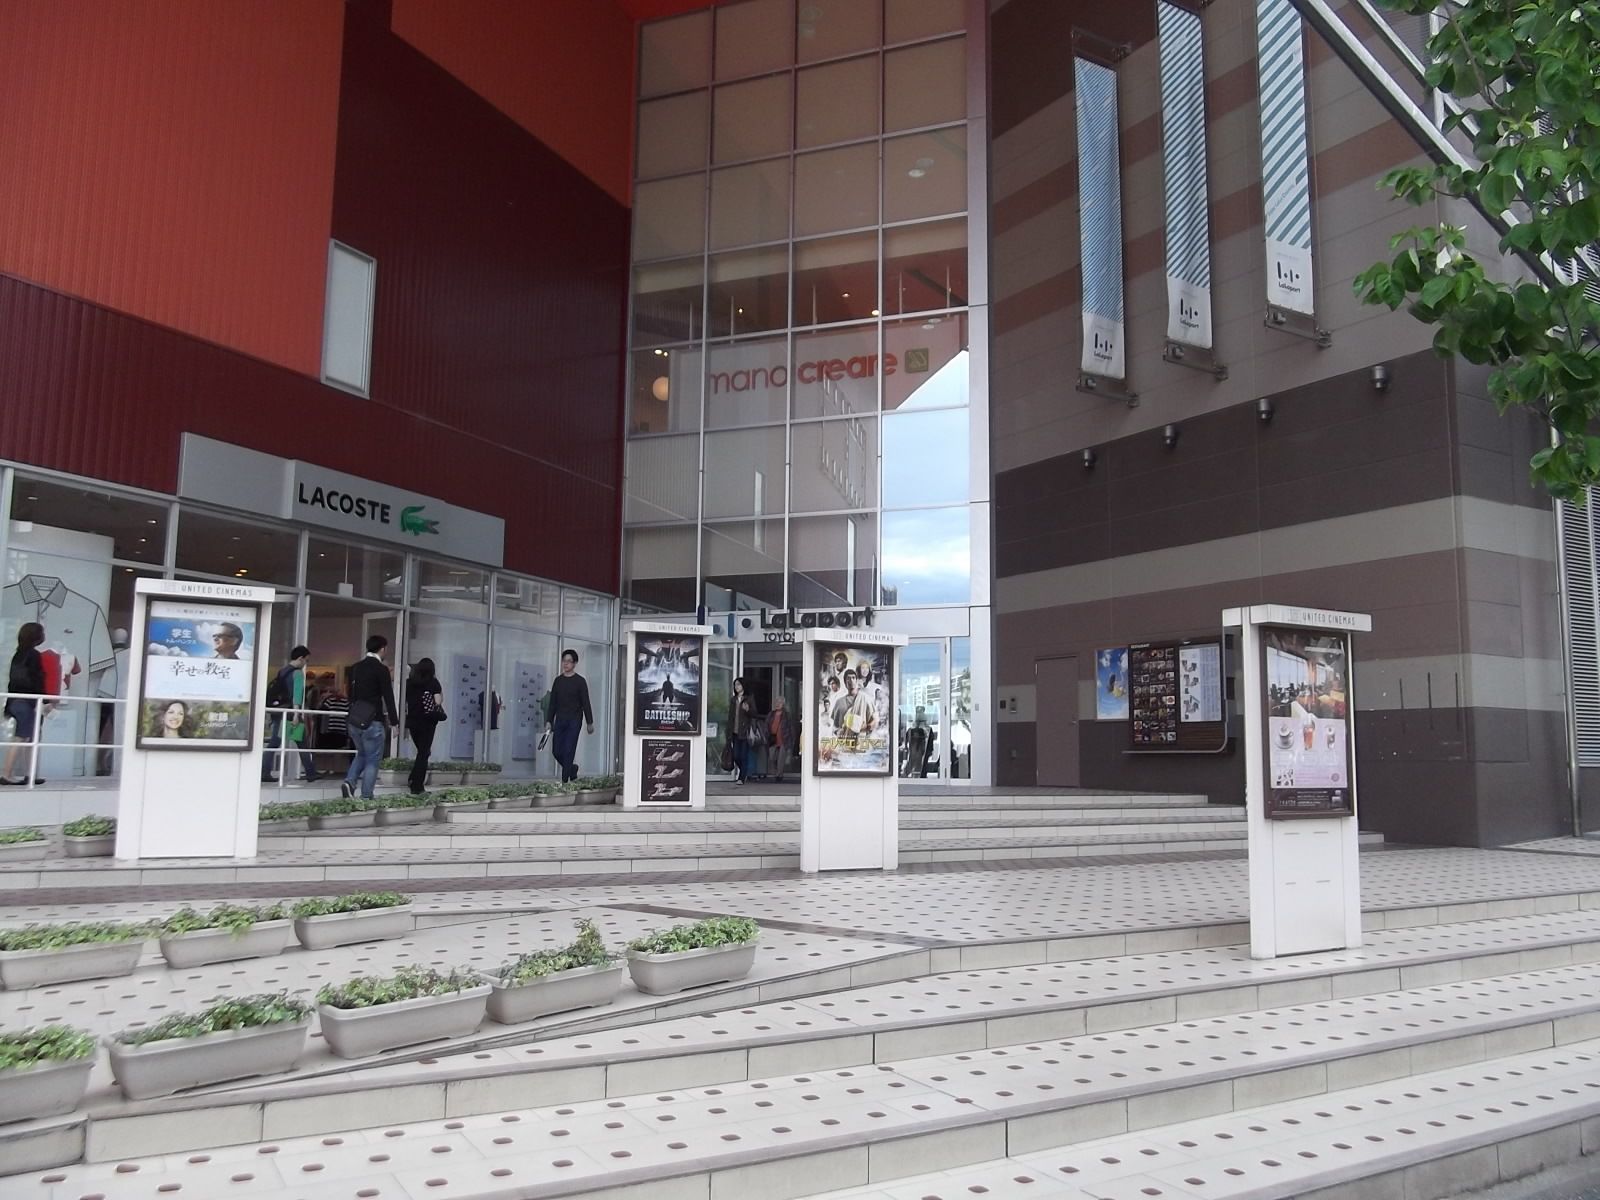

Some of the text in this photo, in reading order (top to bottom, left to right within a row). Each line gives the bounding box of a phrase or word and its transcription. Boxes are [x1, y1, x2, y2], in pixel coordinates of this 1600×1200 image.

[710, 352, 898, 395] mano creare
[298, 482, 391, 524] LACOSTE
[181, 584, 253, 597] UNITED CINEMAS
[760, 606, 875, 629] LaLaport
[1302, 612, 1356, 626] UNITED CINEMAS
[845, 632, 894, 643] UNITED CINEMAS
[644, 709, 691, 721] BATTLESHIP
